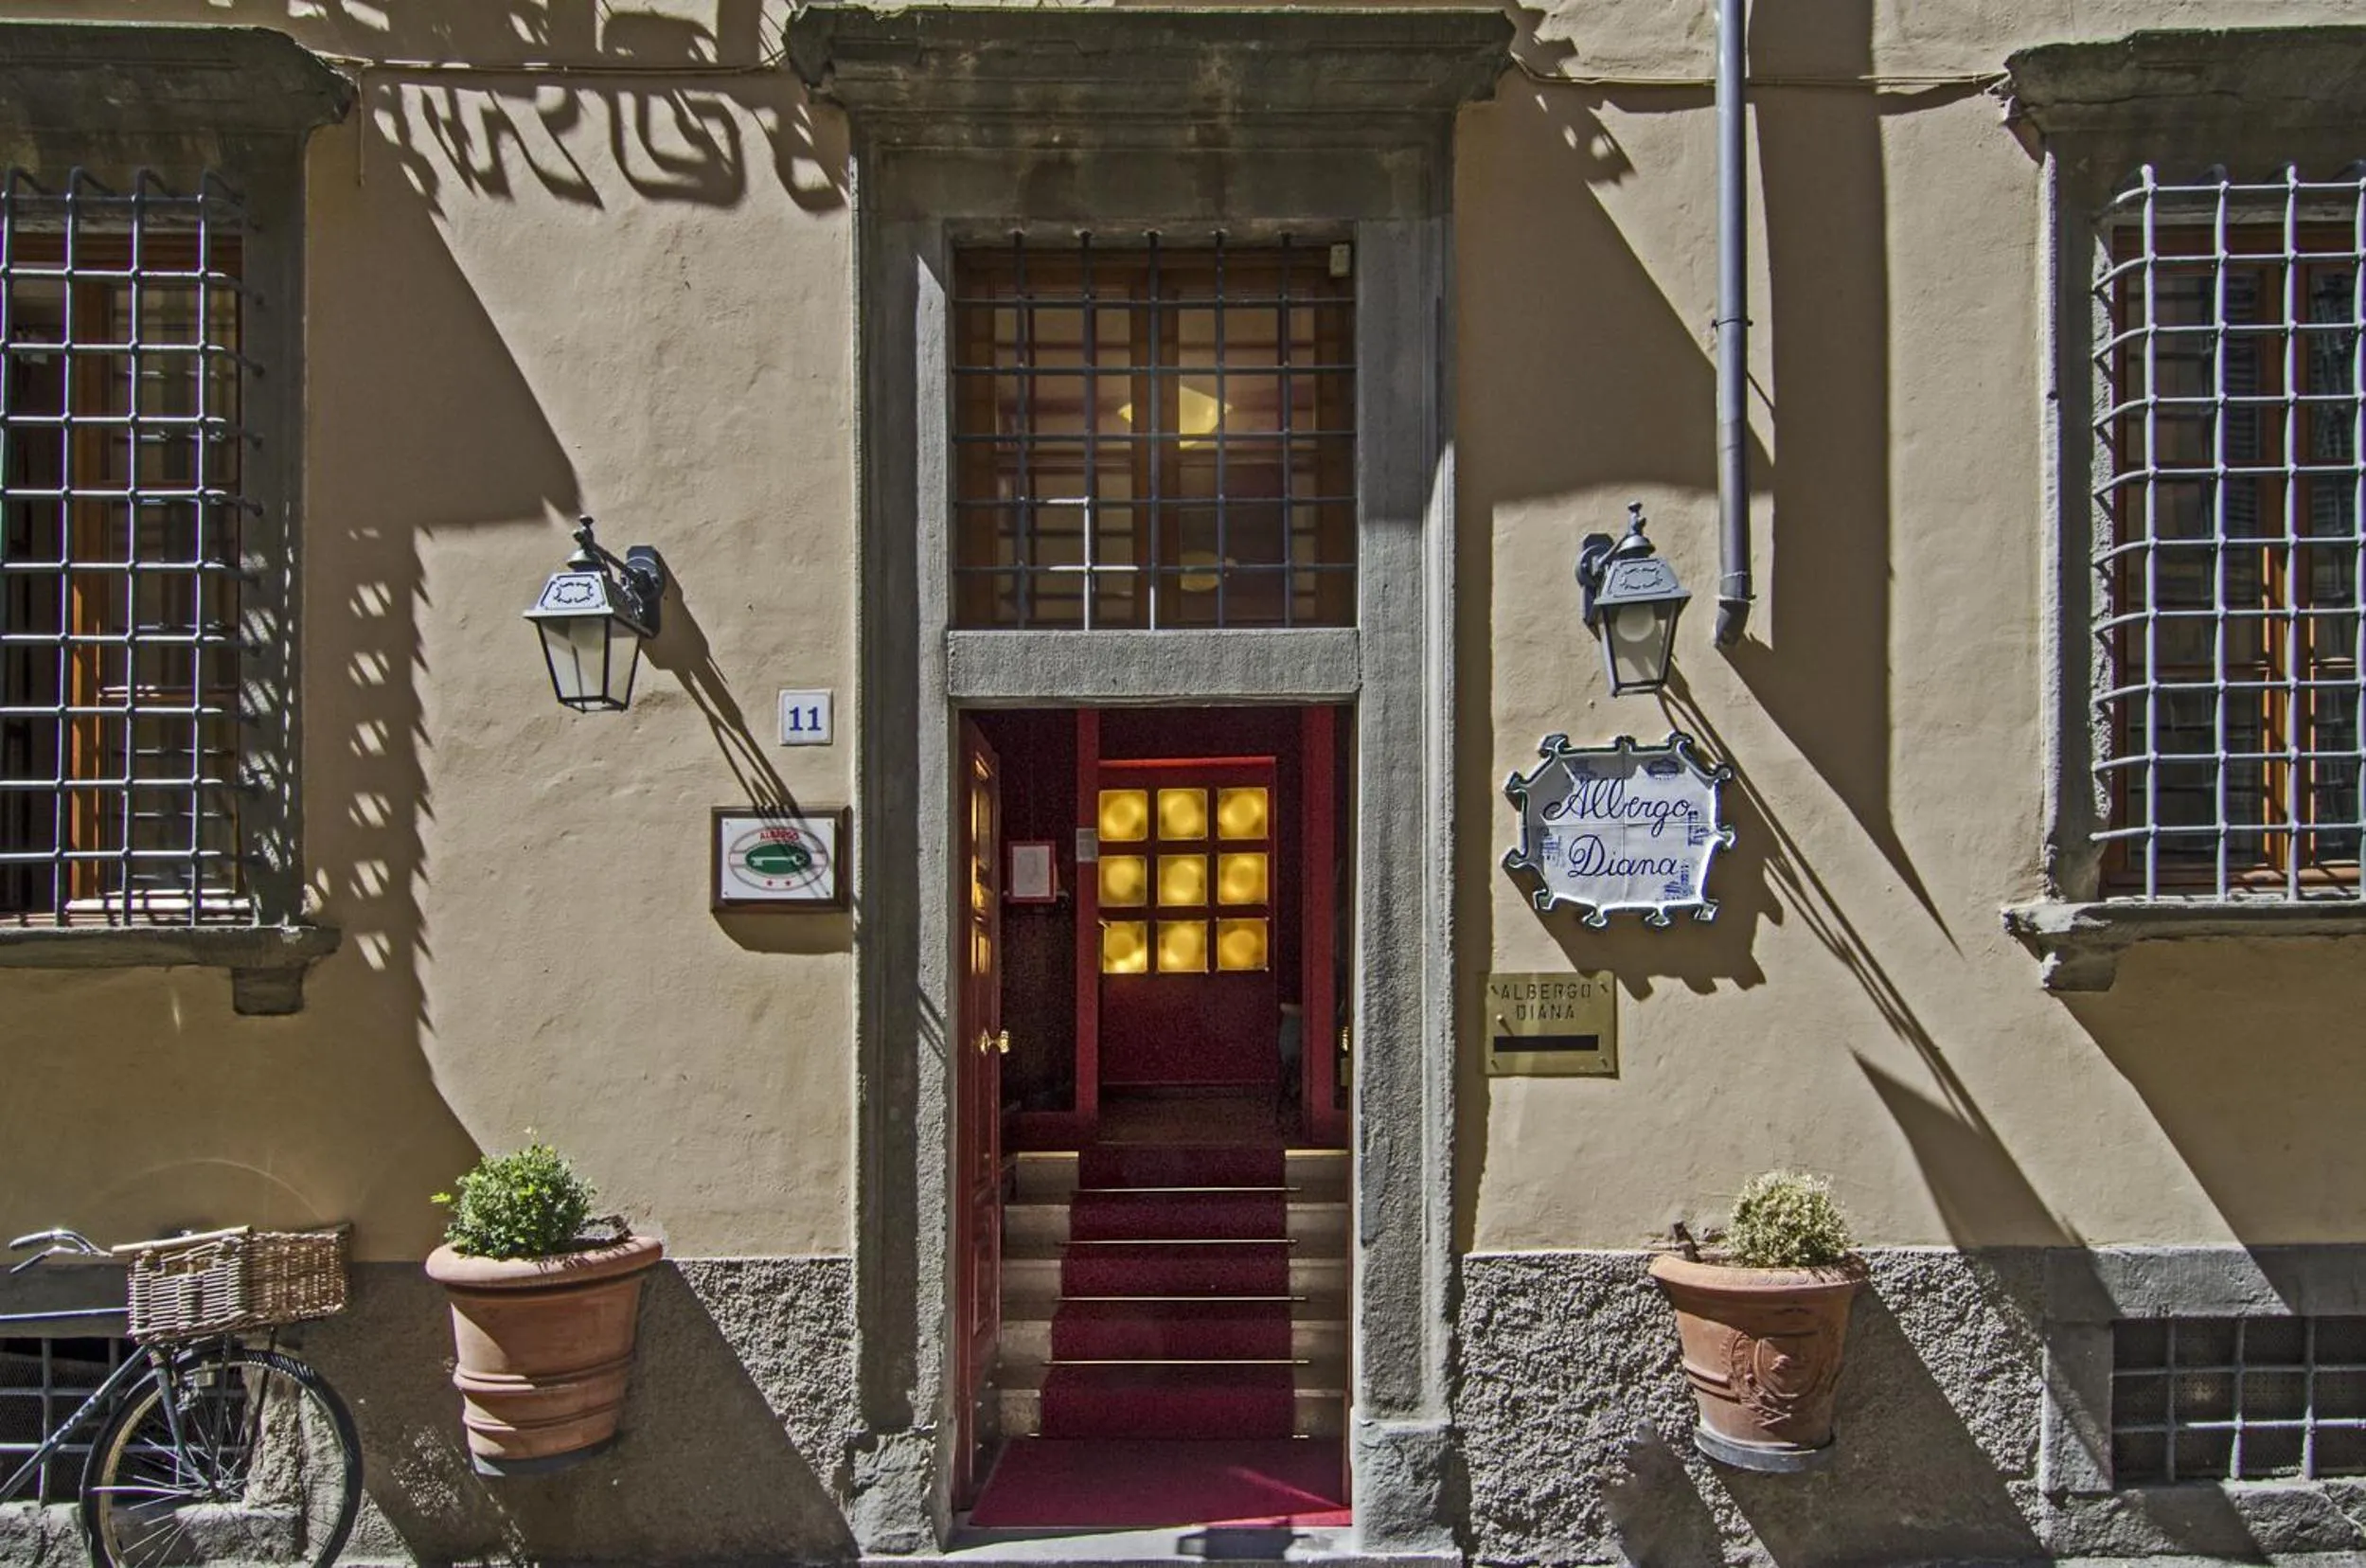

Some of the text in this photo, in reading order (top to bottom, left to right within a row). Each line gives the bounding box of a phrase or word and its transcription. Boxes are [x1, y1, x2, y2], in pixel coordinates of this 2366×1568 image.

[789, 706, 822, 731] 11
[1542, 776, 1692, 838] Albergo
[1568, 833, 1678, 878] Diana
[1501, 983, 1592, 1001] ALBERGO
[1516, 1004, 1575, 1021] DIANA
